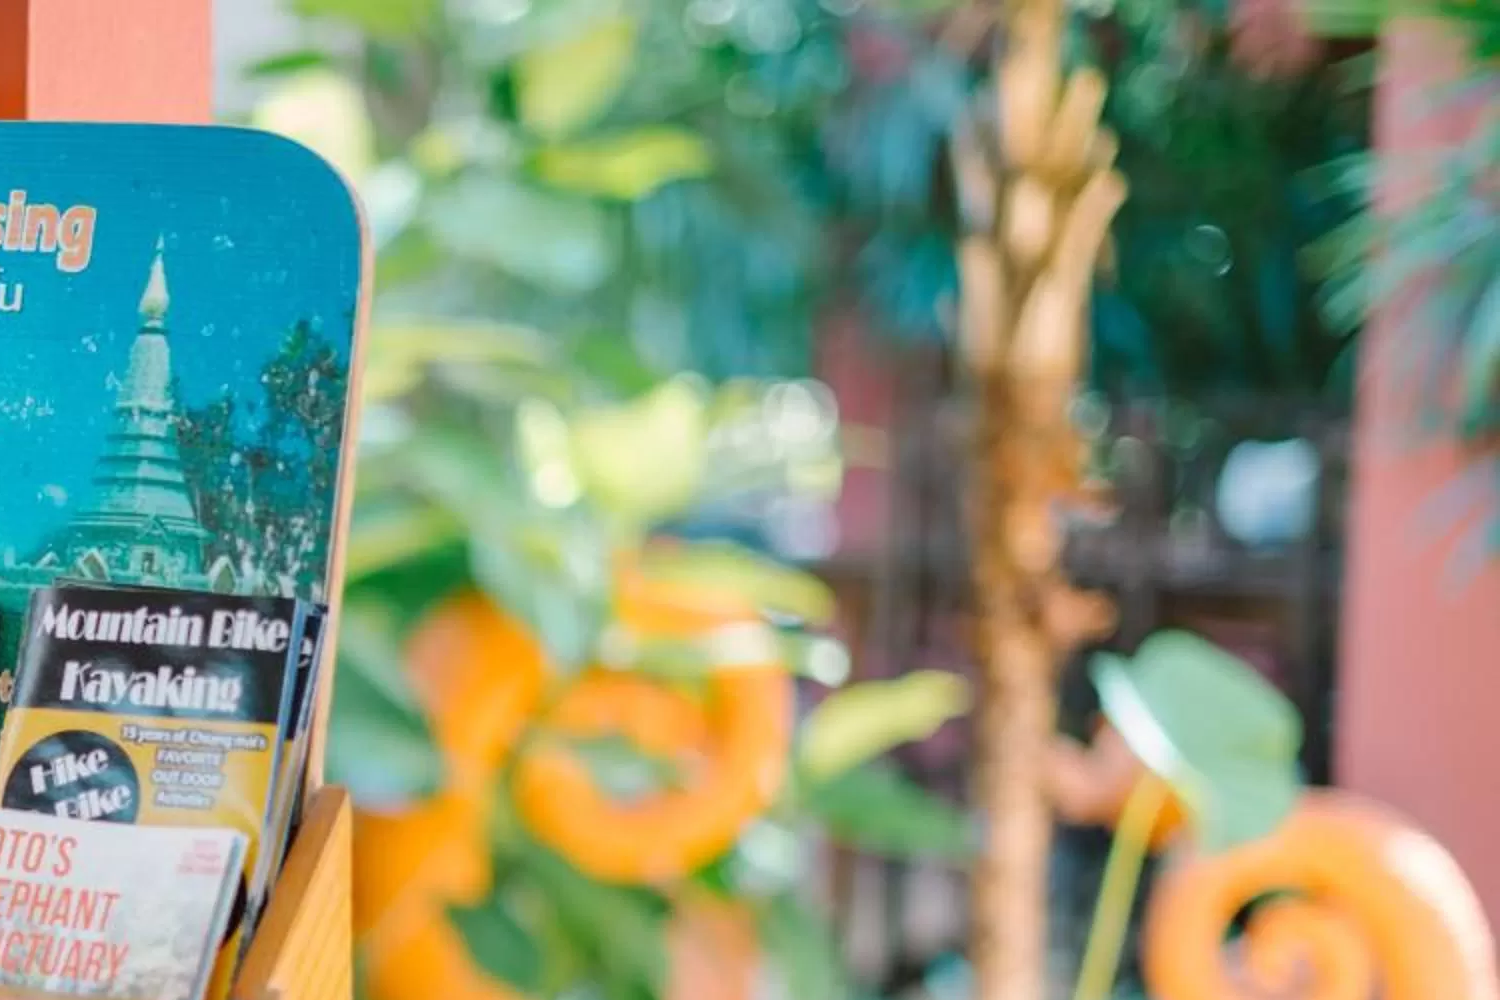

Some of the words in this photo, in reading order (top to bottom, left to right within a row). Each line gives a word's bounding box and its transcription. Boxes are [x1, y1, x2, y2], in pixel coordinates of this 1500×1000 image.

[36, 604, 203, 647] Mountain
[207, 609, 290, 652] Bike
[60, 660, 243, 713] Kayaking
[30, 748, 109, 795] Hike
